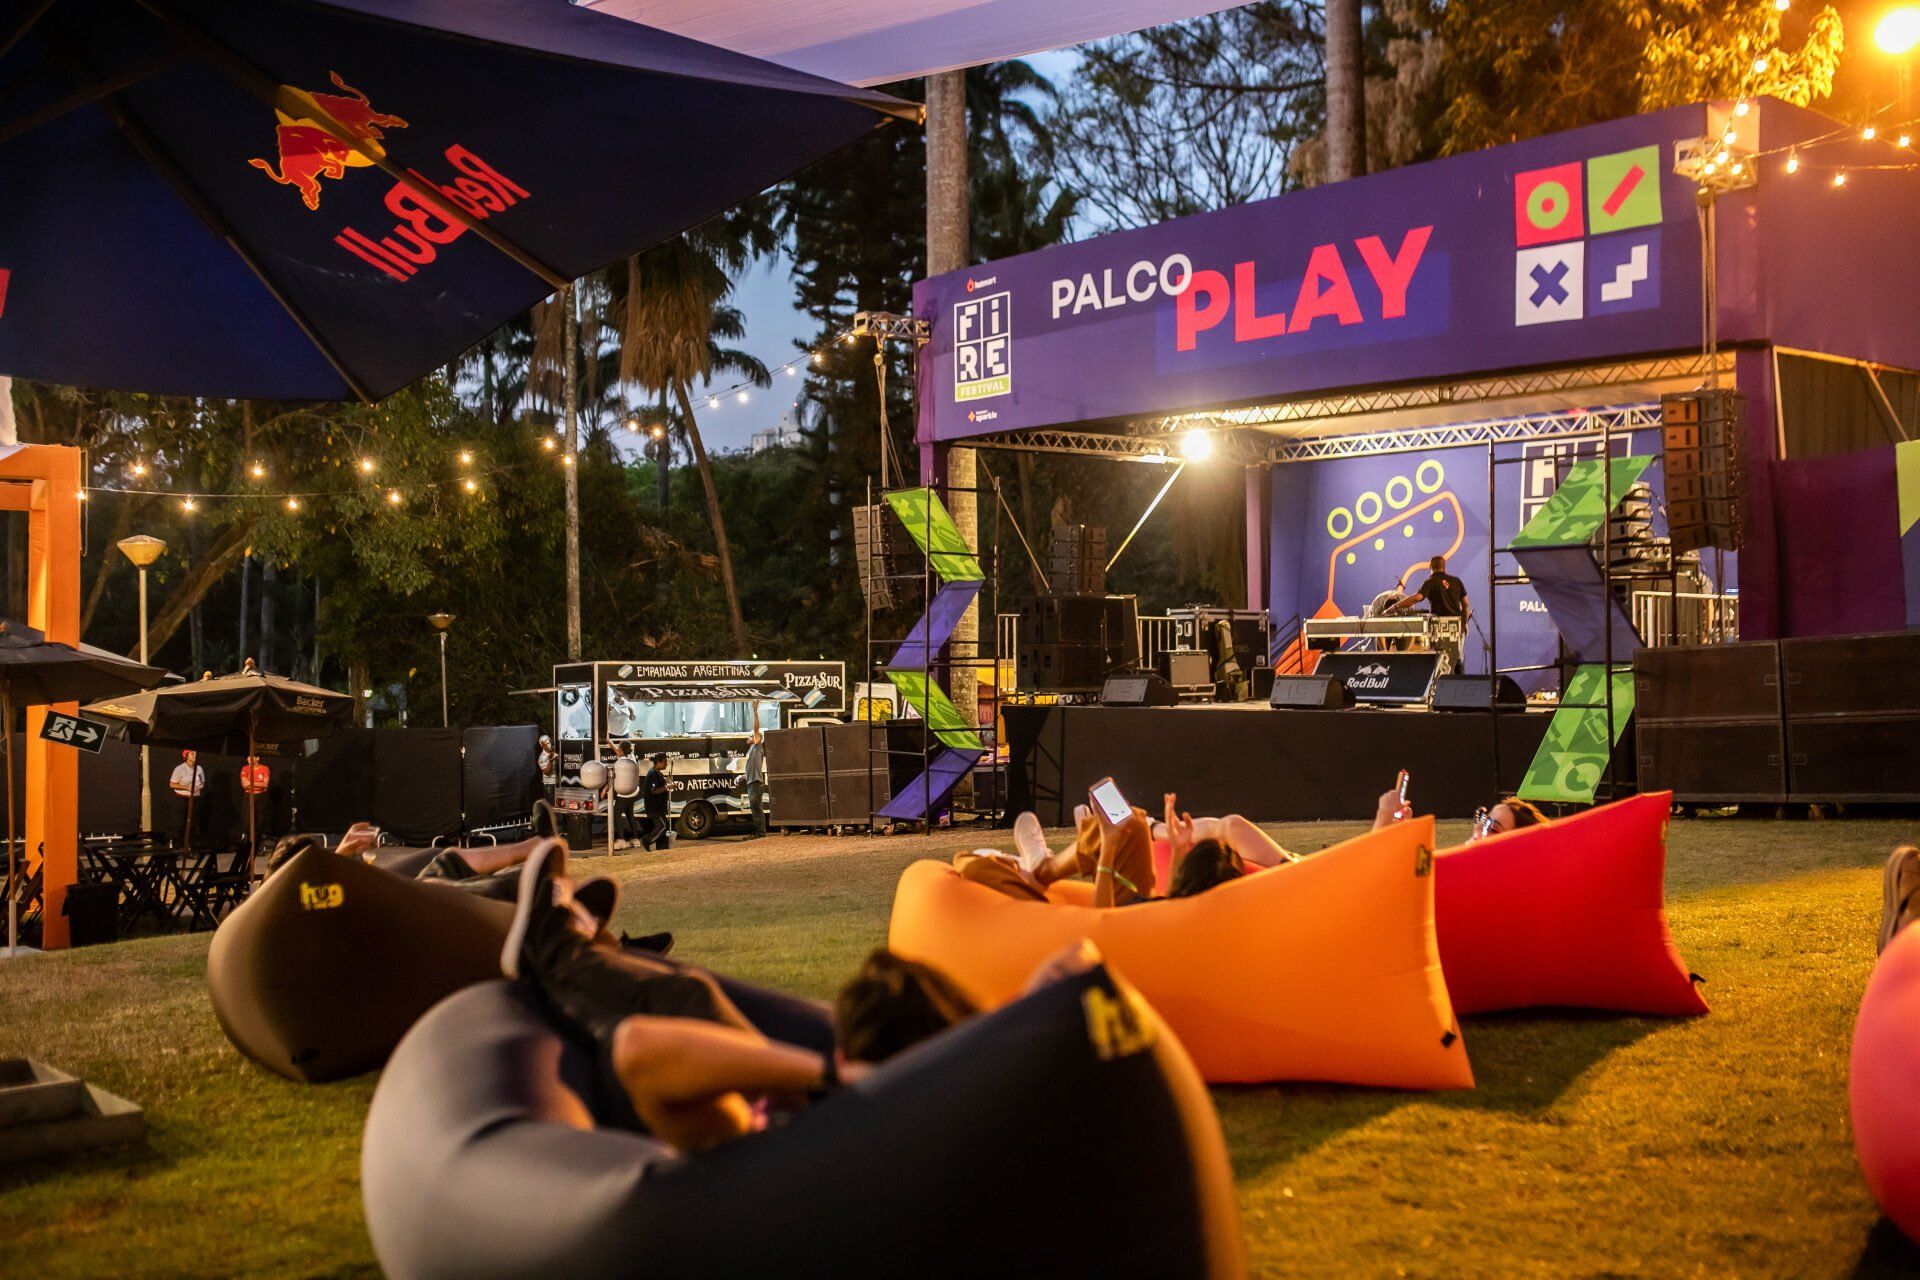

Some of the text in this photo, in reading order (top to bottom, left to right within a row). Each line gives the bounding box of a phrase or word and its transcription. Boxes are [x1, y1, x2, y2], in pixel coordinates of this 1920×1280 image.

[1052, 253, 1193, 319] PALCO
[1176, 225, 1434, 352] PLAY
[960, 381, 1005, 397] FESTIVAL
[636, 665, 751, 678] EMPANADAS ARGENTINAS
[1347, 677, 1390, 689] Red Bull
[296, 695, 325, 707] Backer
[686, 778, 737, 791] ARTESANAL
